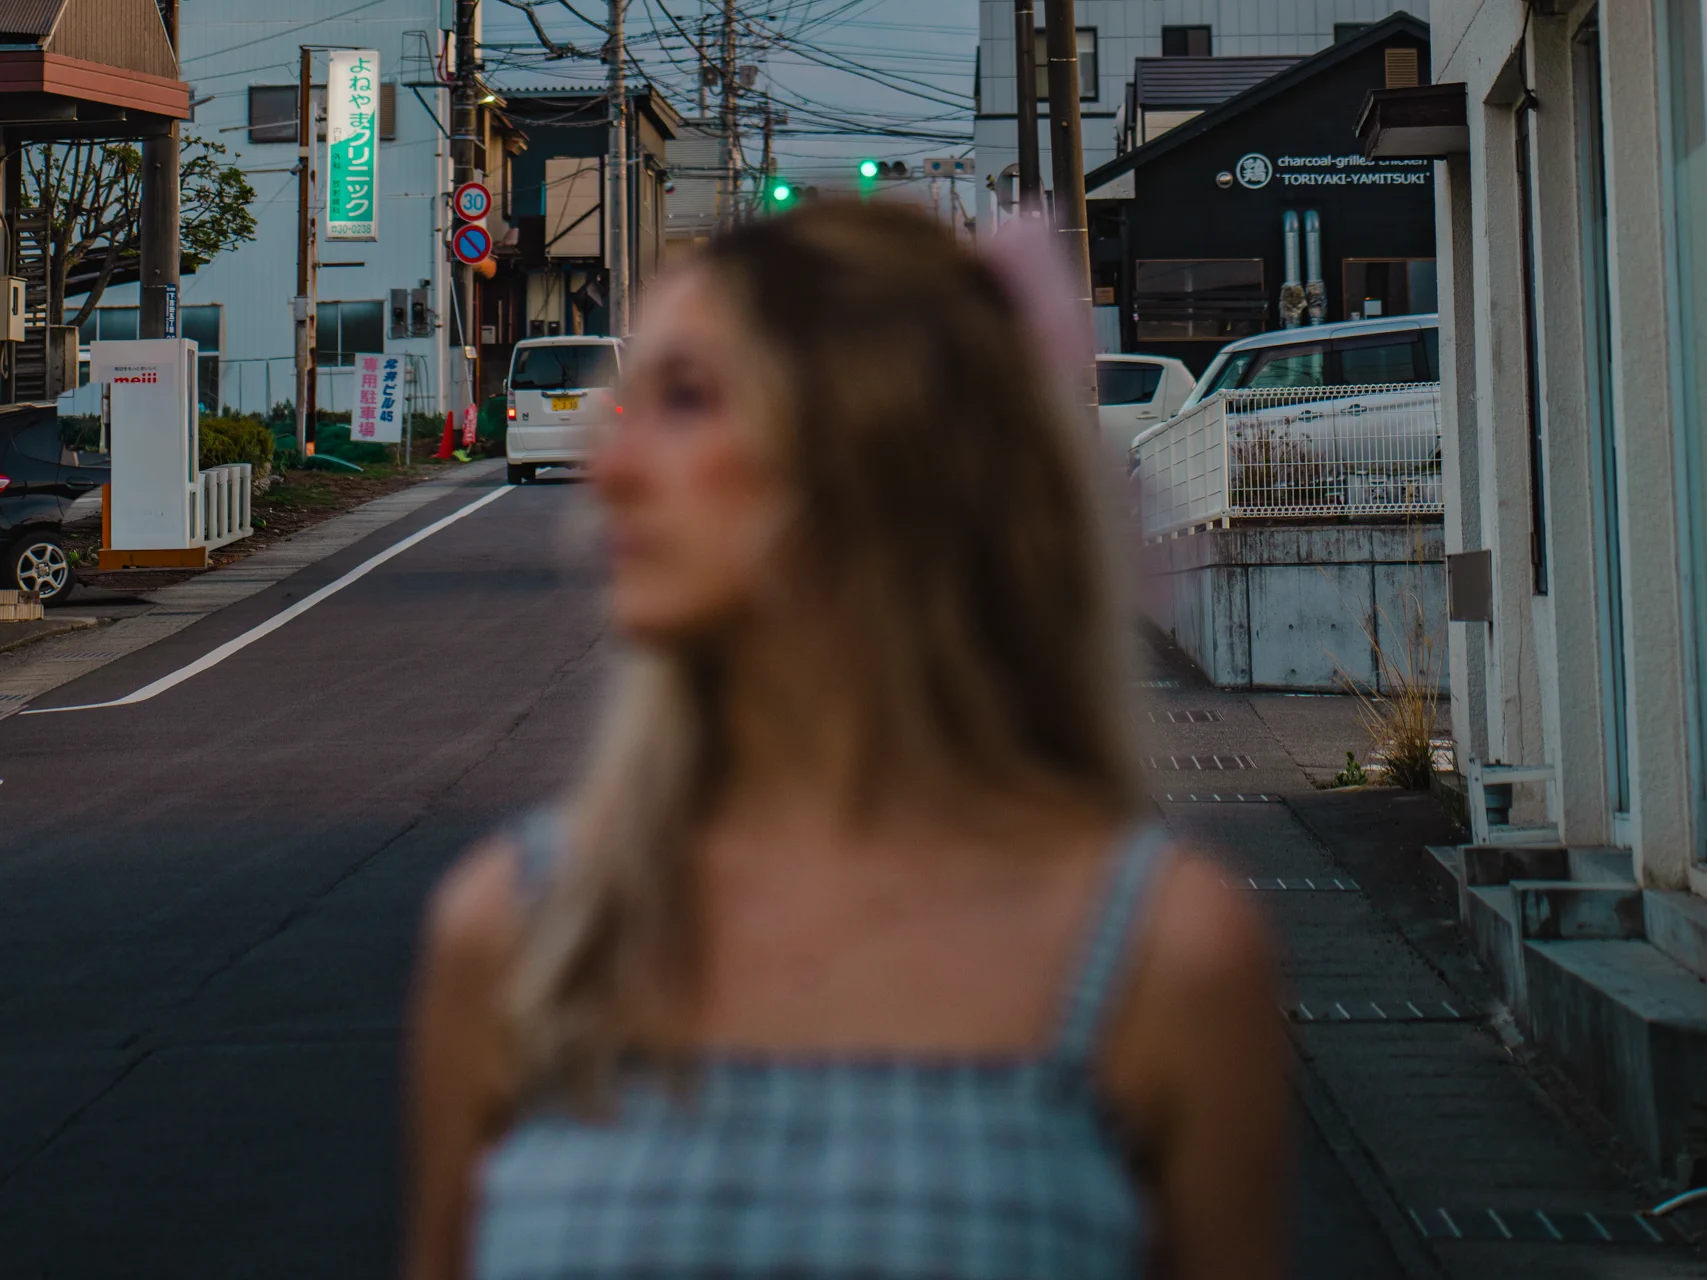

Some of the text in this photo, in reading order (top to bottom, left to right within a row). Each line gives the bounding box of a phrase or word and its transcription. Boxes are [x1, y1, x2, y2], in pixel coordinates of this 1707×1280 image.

[346, 57, 371, 217] よねやまクリニック
[463, 193, 484, 211] 30
[359, 357, 378, 437] 専用駐車場
